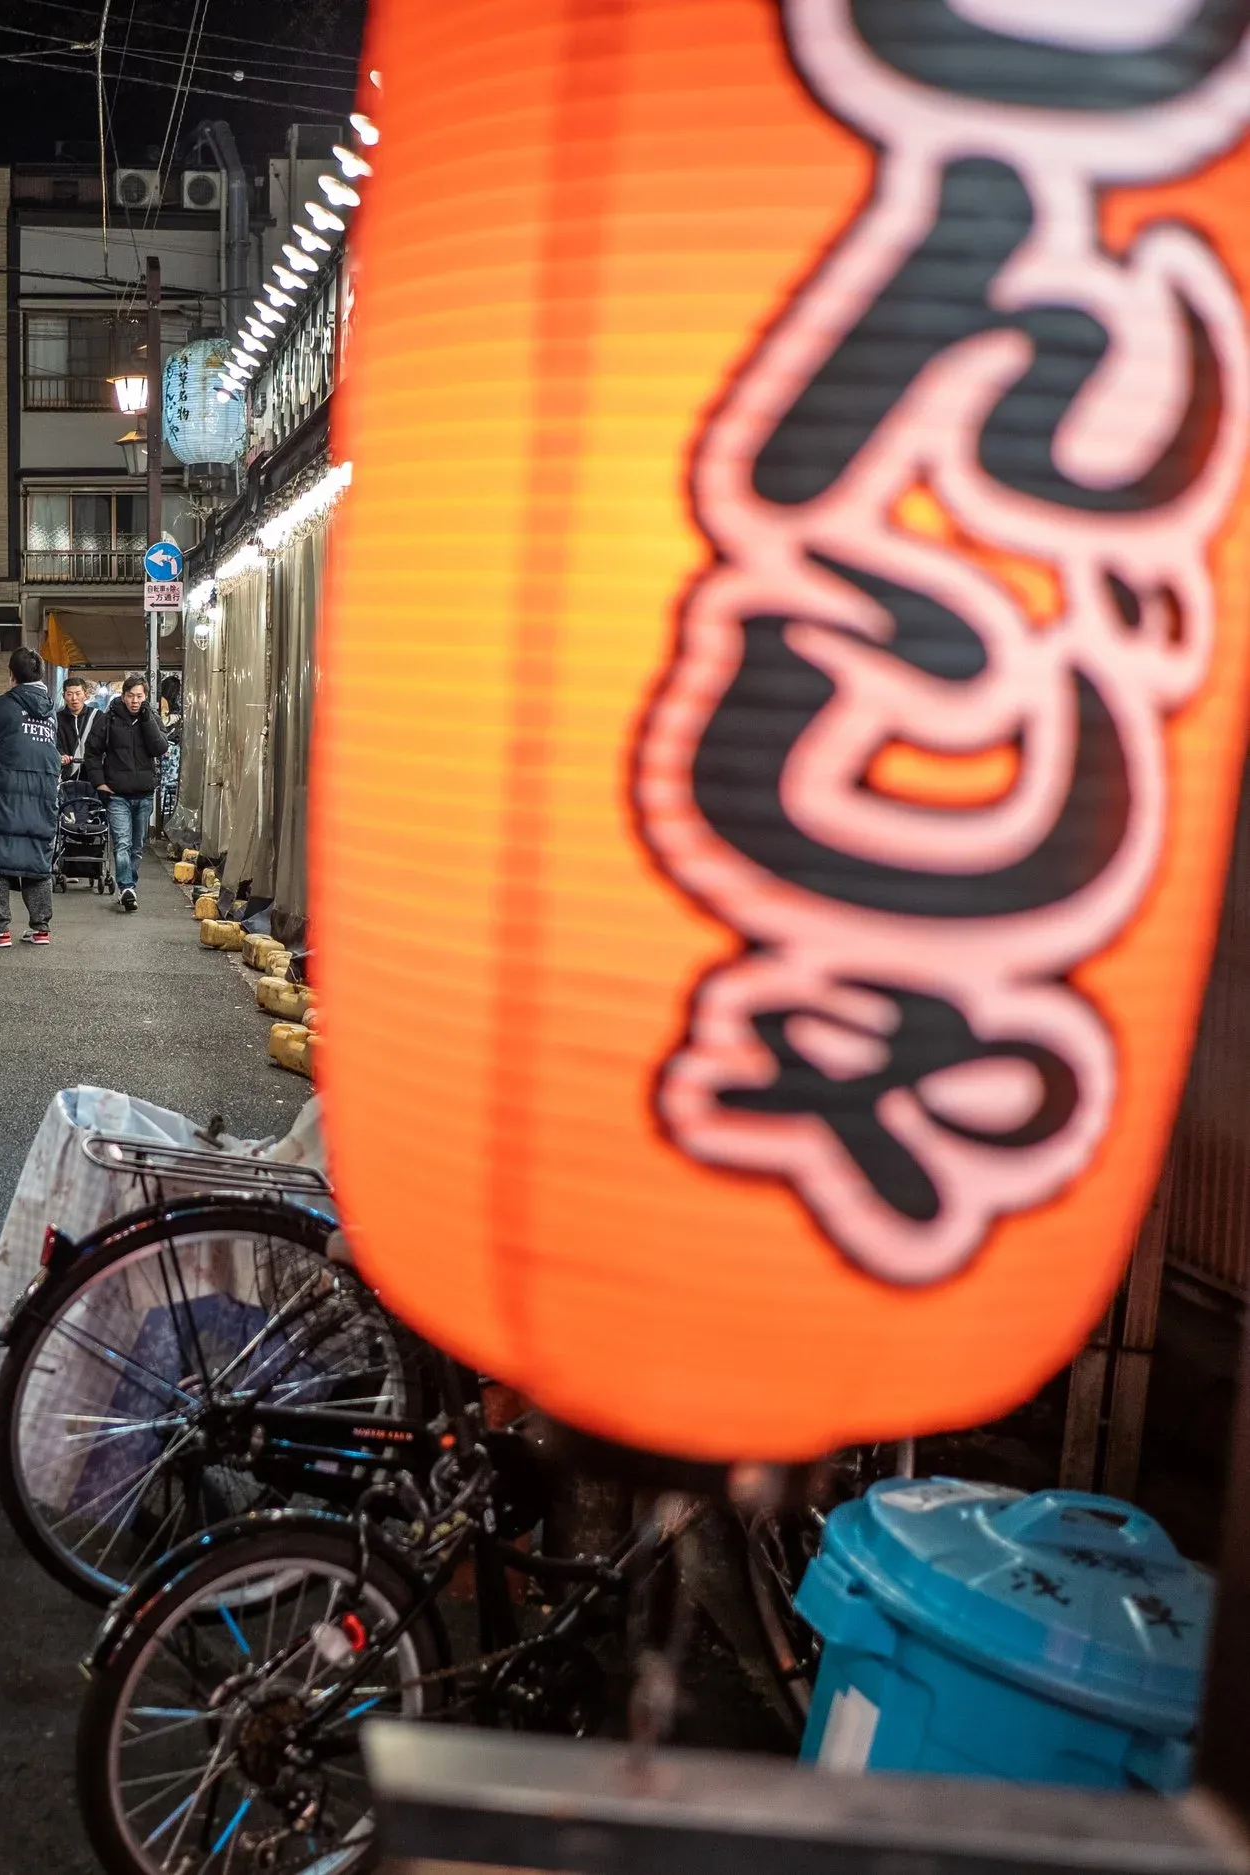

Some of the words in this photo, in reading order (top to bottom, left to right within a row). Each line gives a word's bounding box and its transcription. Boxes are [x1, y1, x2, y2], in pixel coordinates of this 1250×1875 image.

[147, 585, 180, 594] 自転車を除く
[146, 593, 180, 602] 一方通行
